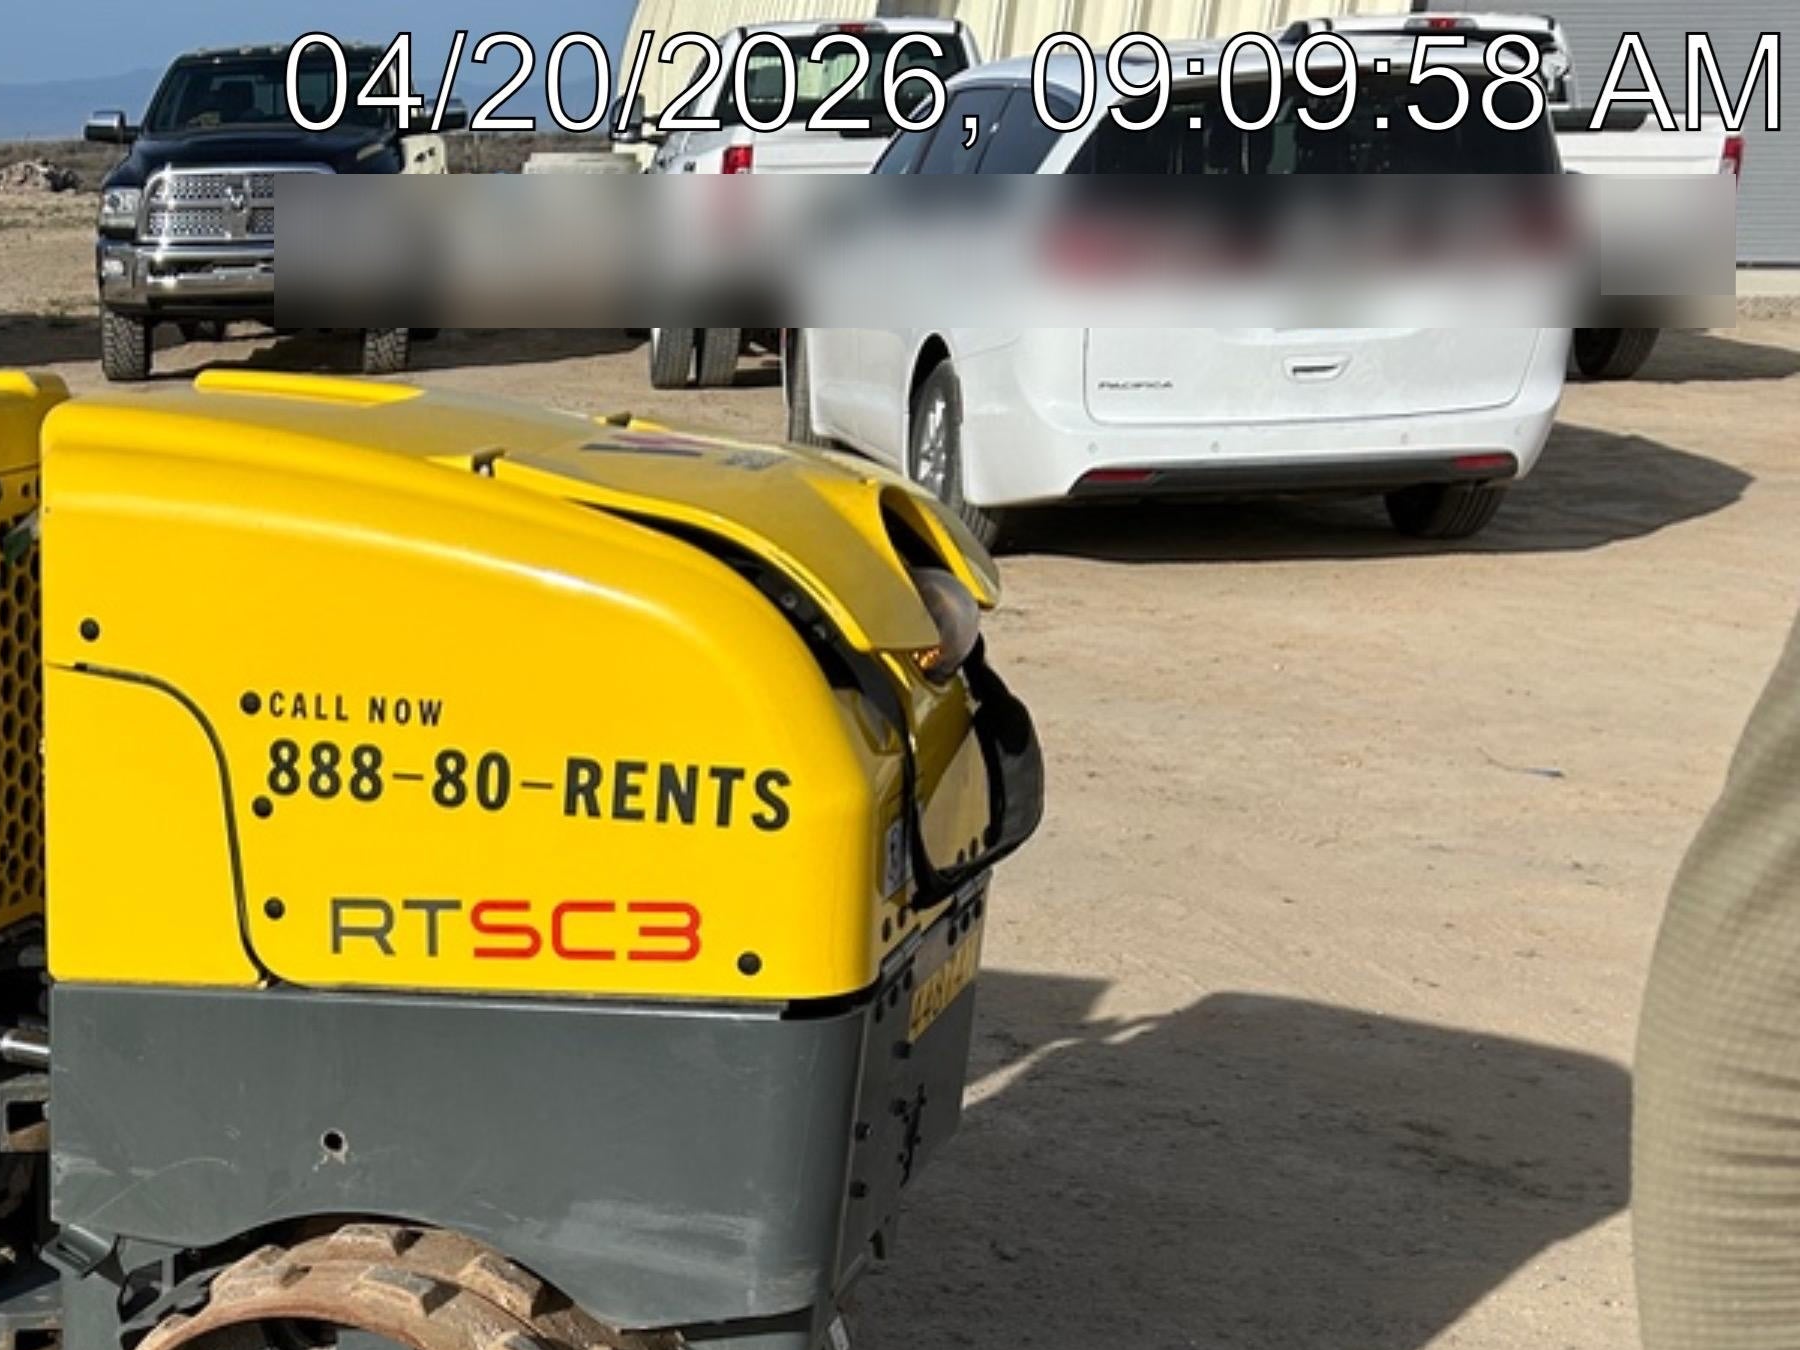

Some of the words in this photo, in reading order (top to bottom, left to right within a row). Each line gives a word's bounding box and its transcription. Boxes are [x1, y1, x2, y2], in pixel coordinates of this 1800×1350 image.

[269, 691, 349, 722] CALL
[368, 697, 443, 727] NOW
[330, 897, 702, 961] RTSC3
